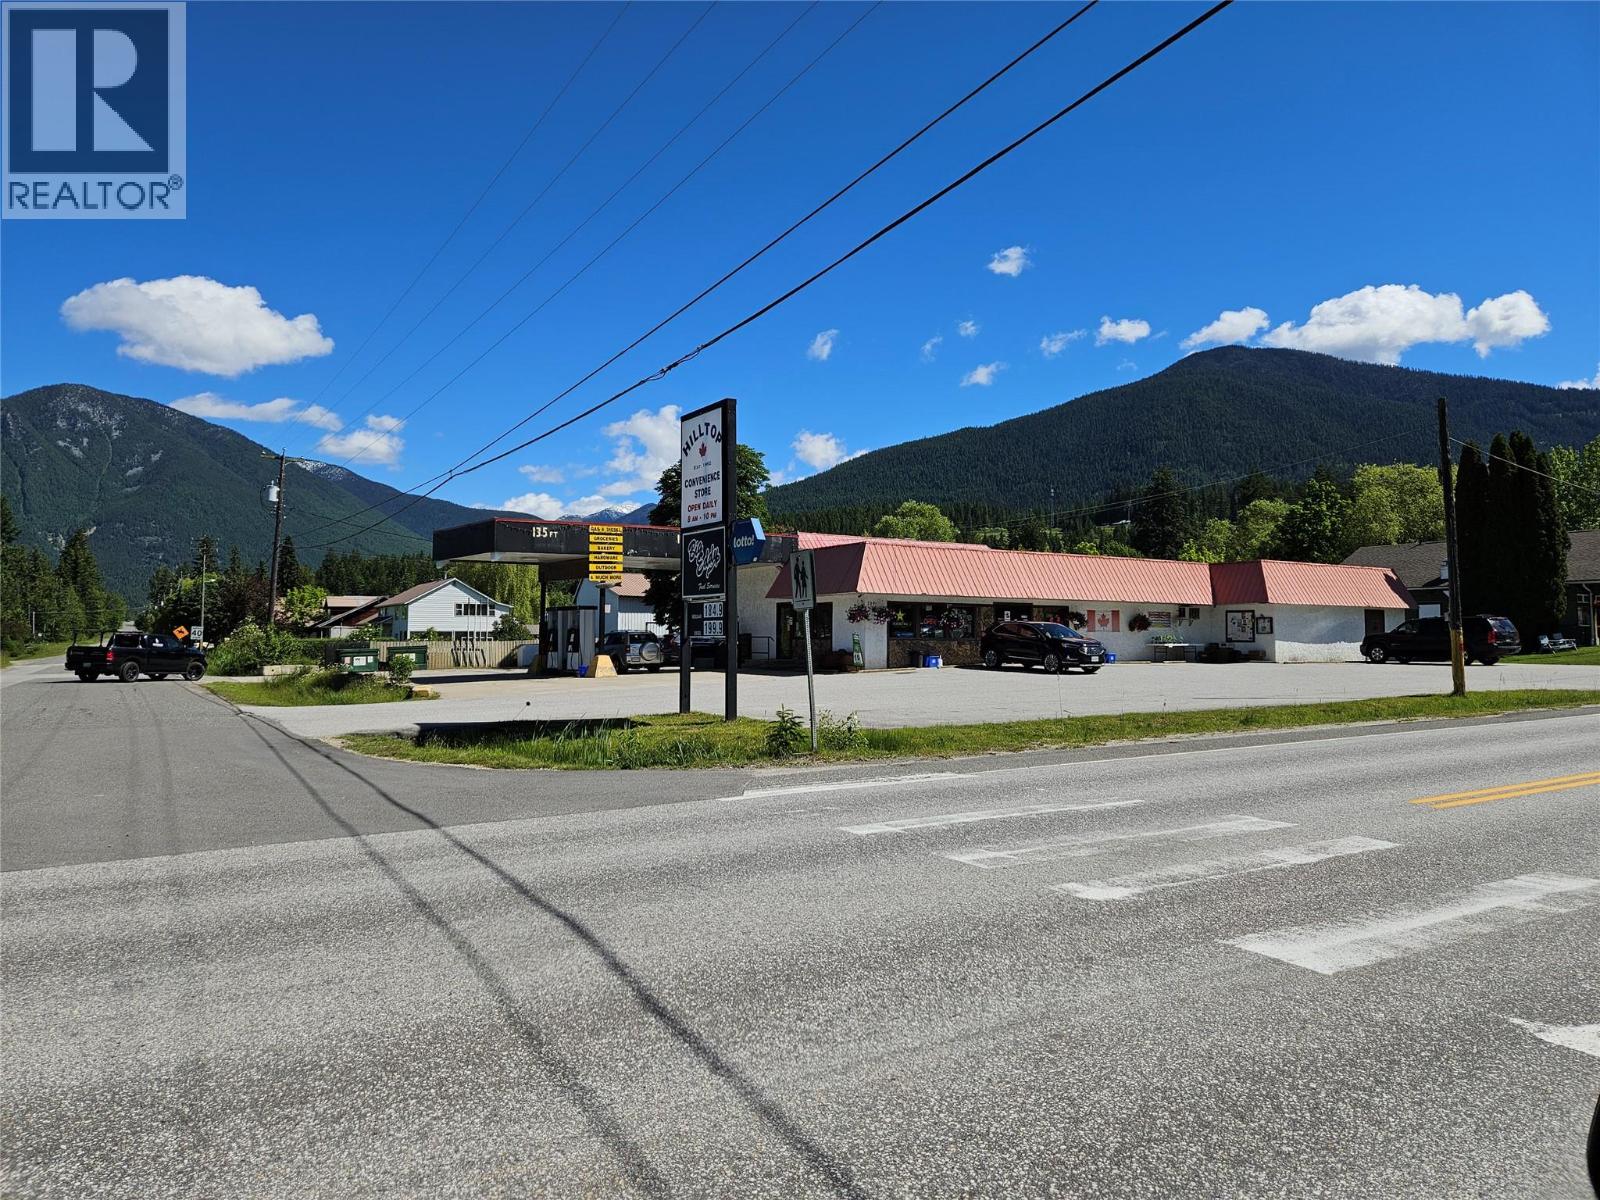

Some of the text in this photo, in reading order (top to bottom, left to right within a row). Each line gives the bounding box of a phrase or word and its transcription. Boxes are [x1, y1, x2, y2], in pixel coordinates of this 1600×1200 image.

[682, 422, 723, 457] HILLTOP
[684, 471, 720, 488] CONVENIENCE
[694, 487, 711, 498] STORE
[687, 500, 718, 513] OPEN DAILY
[703, 512, 710, 520] 10
[704, 602, 724, 617] 184.9
[704, 621, 724, 635] 199.9
